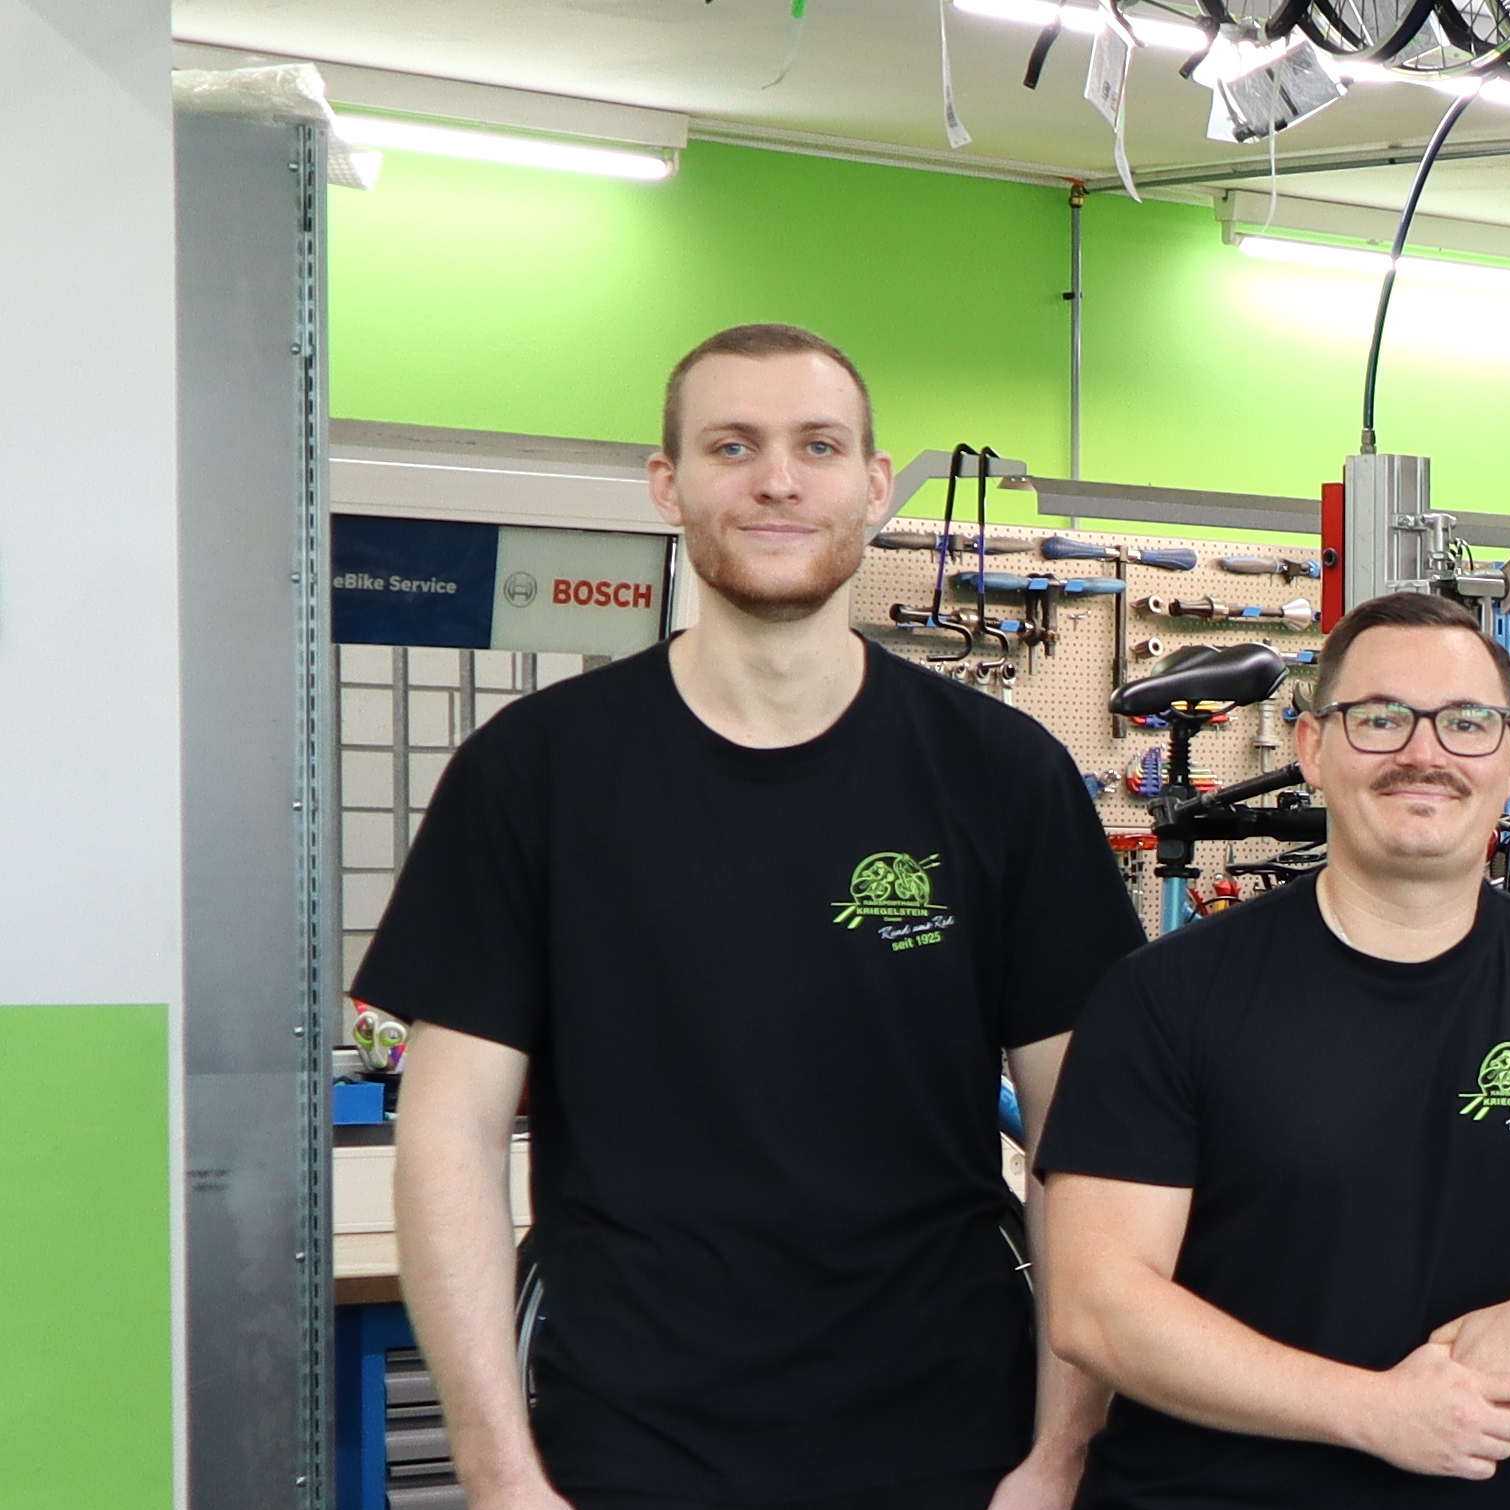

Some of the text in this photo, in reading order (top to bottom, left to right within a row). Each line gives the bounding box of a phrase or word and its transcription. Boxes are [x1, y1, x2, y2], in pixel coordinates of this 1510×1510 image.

[333, 574, 457, 594] eBike Service
[552, 578, 652, 609] BOSCH
[856, 907, 929, 916] KRIEGELSTEIN
[892, 931, 942, 952] seit 1925
